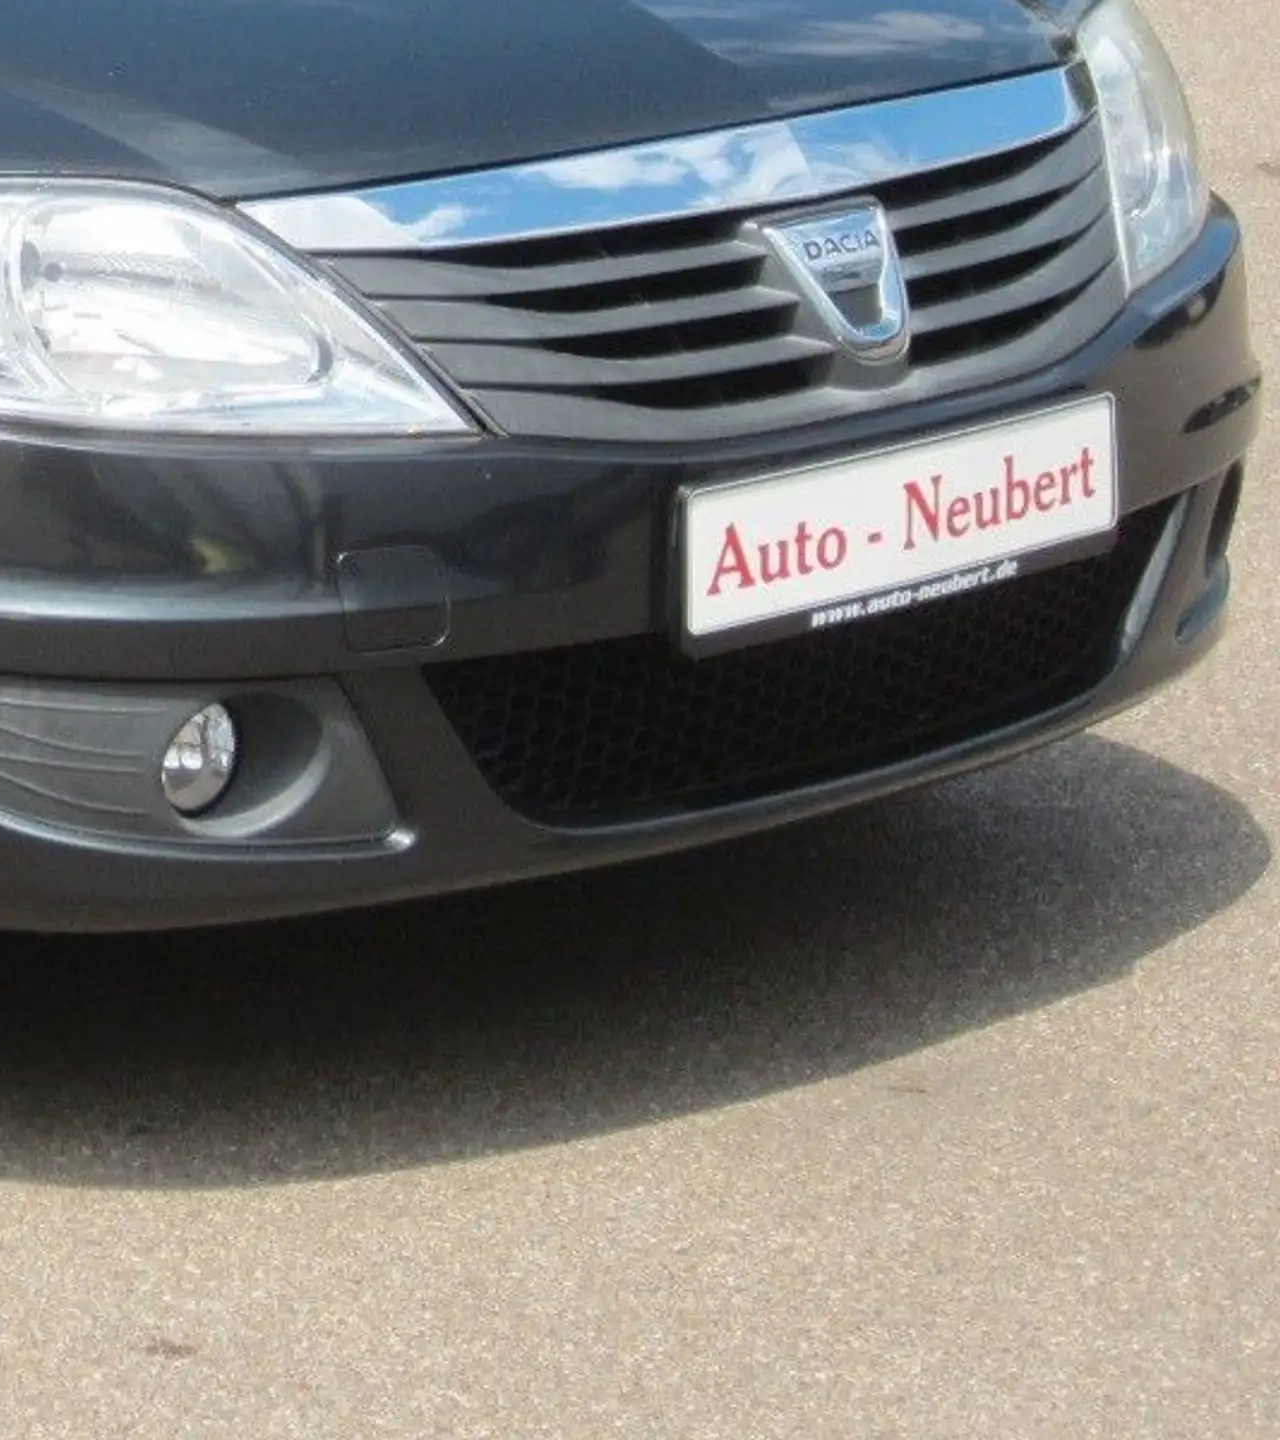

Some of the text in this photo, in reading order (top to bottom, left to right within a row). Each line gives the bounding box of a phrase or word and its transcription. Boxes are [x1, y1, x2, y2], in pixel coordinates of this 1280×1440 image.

[803, 229, 880, 260] DACIA
[706, 447, 1095, 597] Auto - Neubert
[810, 560, 1018, 629] www.auto-neubert.de
